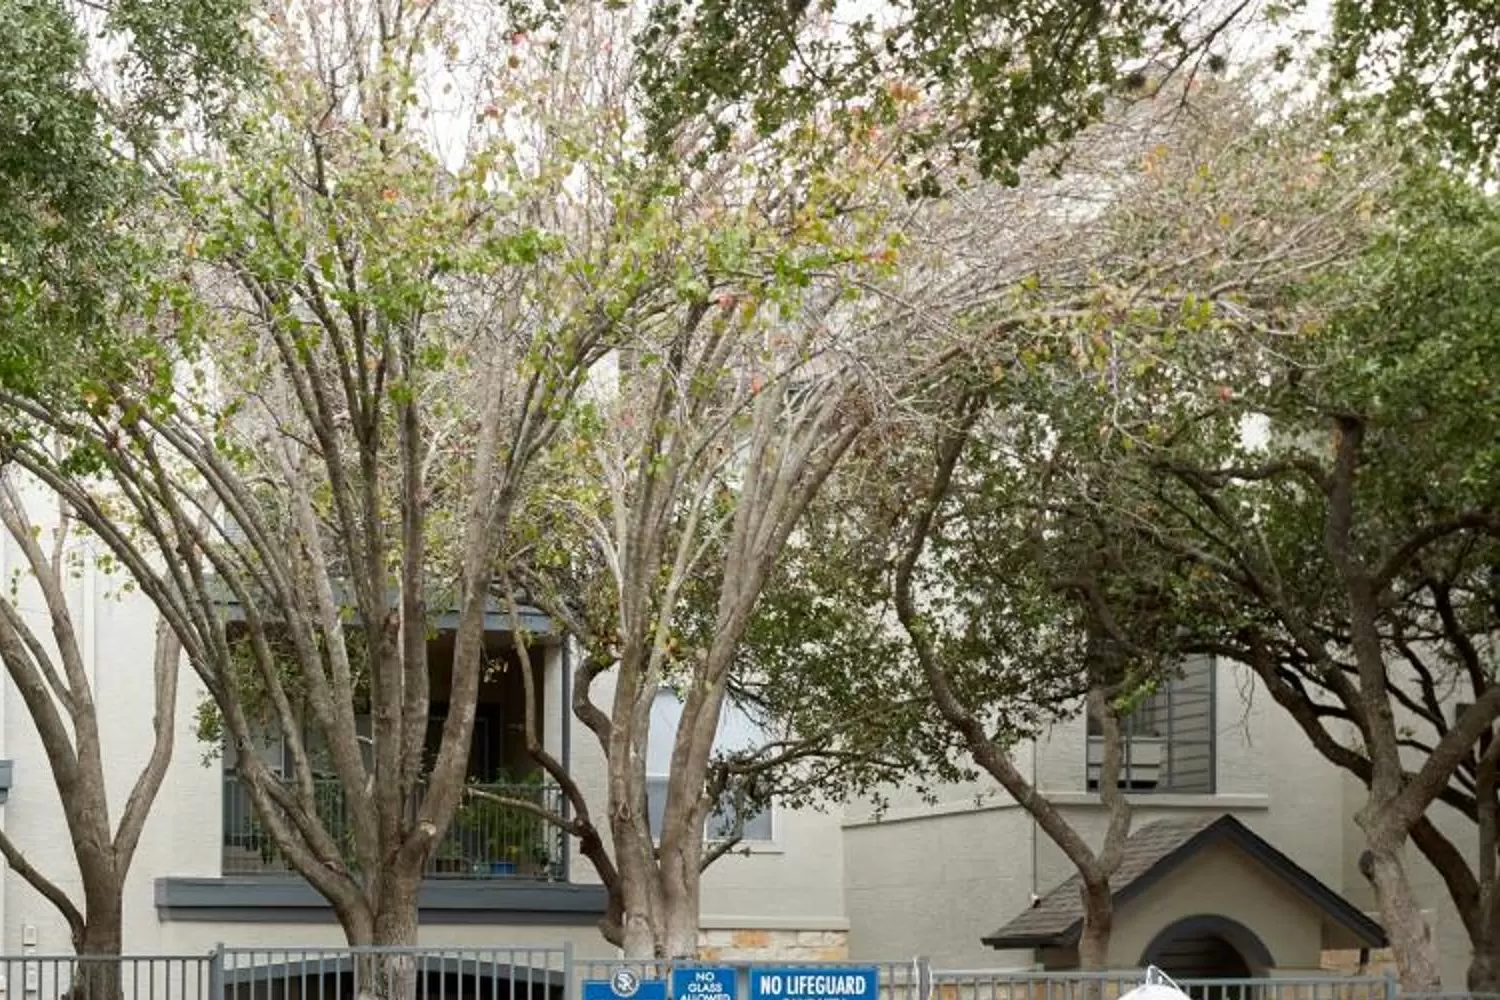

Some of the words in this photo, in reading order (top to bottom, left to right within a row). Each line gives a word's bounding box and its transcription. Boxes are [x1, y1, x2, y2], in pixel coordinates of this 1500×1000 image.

[696, 971, 714, 981] NO
[688, 983, 723, 993] GLASS
[761, 976, 782, 994] NO
[787, 975, 866, 994] LIFEGUARD
